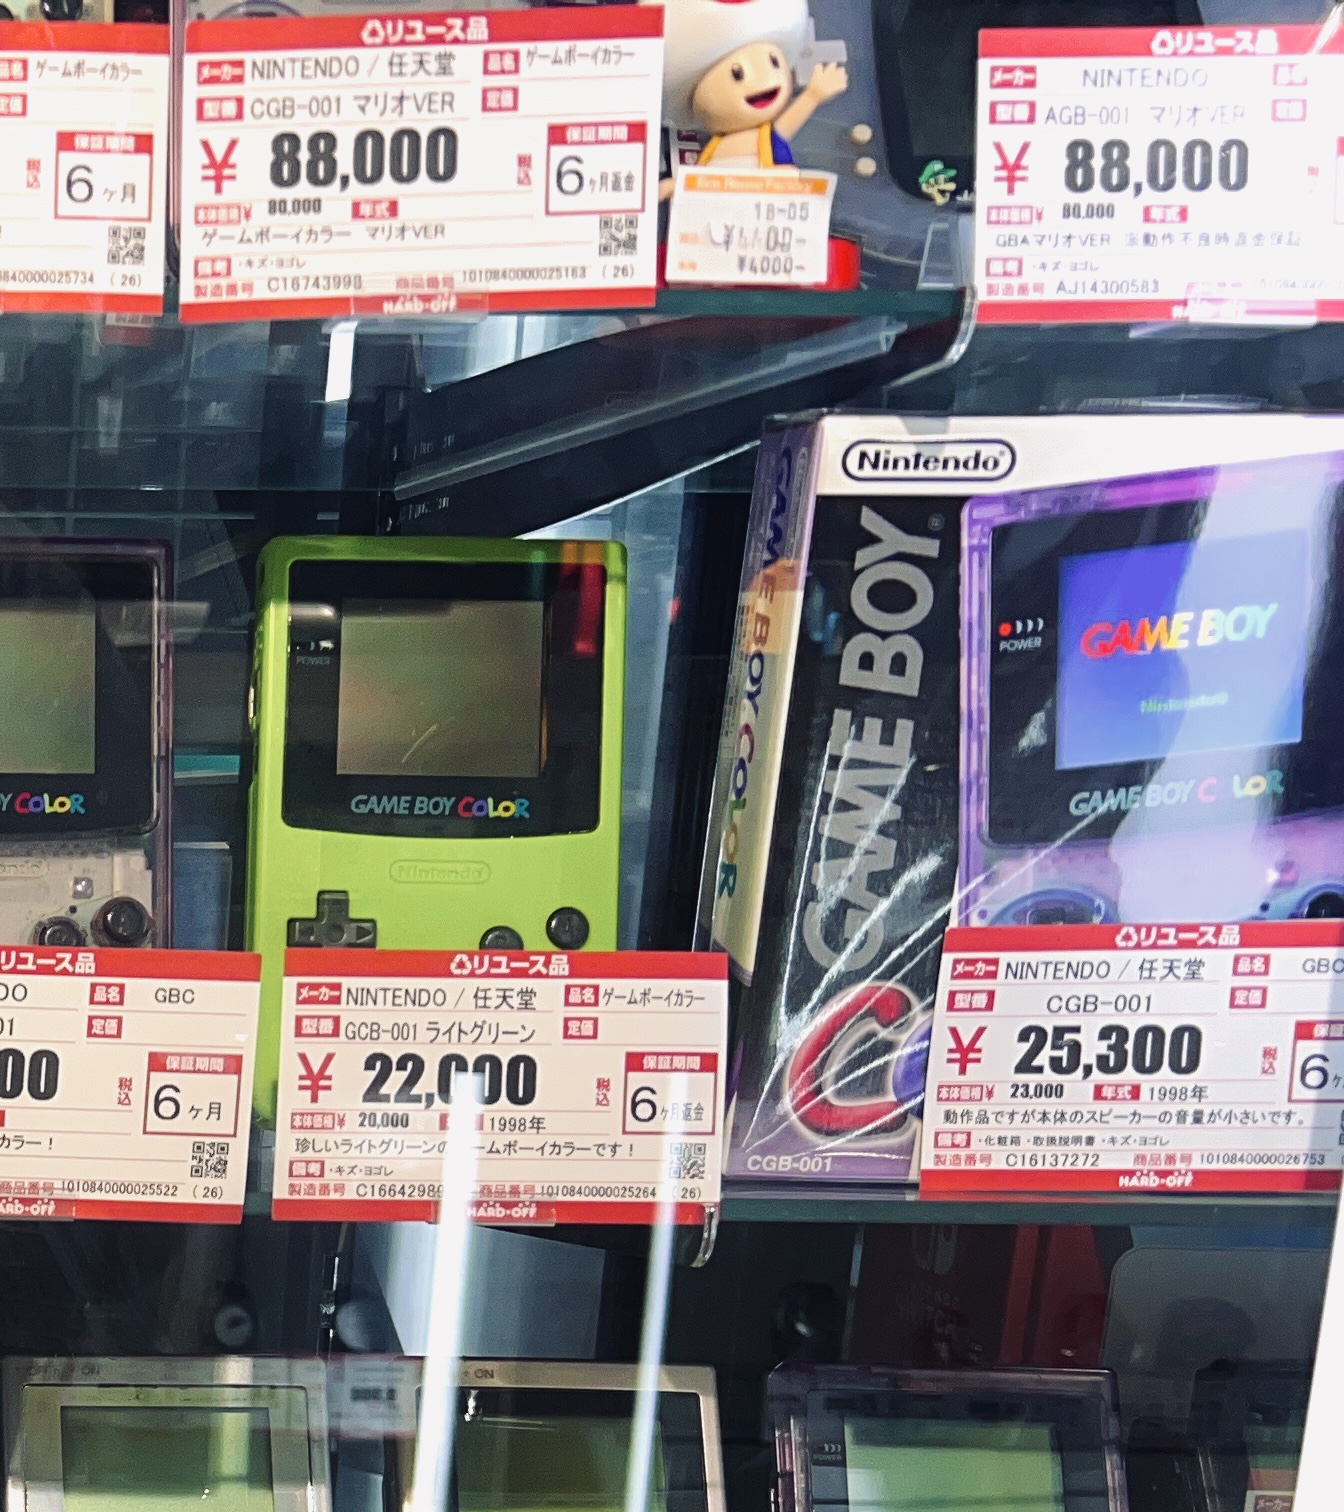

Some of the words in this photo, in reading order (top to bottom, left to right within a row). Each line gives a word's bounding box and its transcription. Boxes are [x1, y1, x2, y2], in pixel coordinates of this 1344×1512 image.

[251, 55, 360, 80] NINTENDO
[1082, 67, 1209, 89] NINTENDO
[250, 96, 341, 120] CGB-001
[353, 91, 456, 117] マリオVER
[1045, 105, 1130, 126] AGB-001
[269, 127, 459, 192] 88,000
[1062, 138, 1250, 199] 88,000
[857, 449, 1004, 474] Nintendo
[838, 503, 943, 699] BOY
[1079, 613, 1190, 661] GAME
[1196, 602, 1279, 647] BOY
[350, 794, 410, 815] GAME
[413, 796, 457, 817] BOY
[457, 796, 531, 819] COLOR
[800, 707, 916, 974] GAME
[1004, 959, 1111, 981] NINTENDO
[346, 987, 447, 1008] NINTENDO
[1046, 993, 1153, 1015] CGB-001
[344, 1022, 418, 1042] GCB-001
[426, 1024, 536, 1045] ライトグリーン
[1013, 1023, 1202, 1080] 25,300
[362, 1052, 537, 1110] 22,000
[746, 1154, 833, 1173] CGB-001
[1005, 1152, 1100, 1169] C16137272
